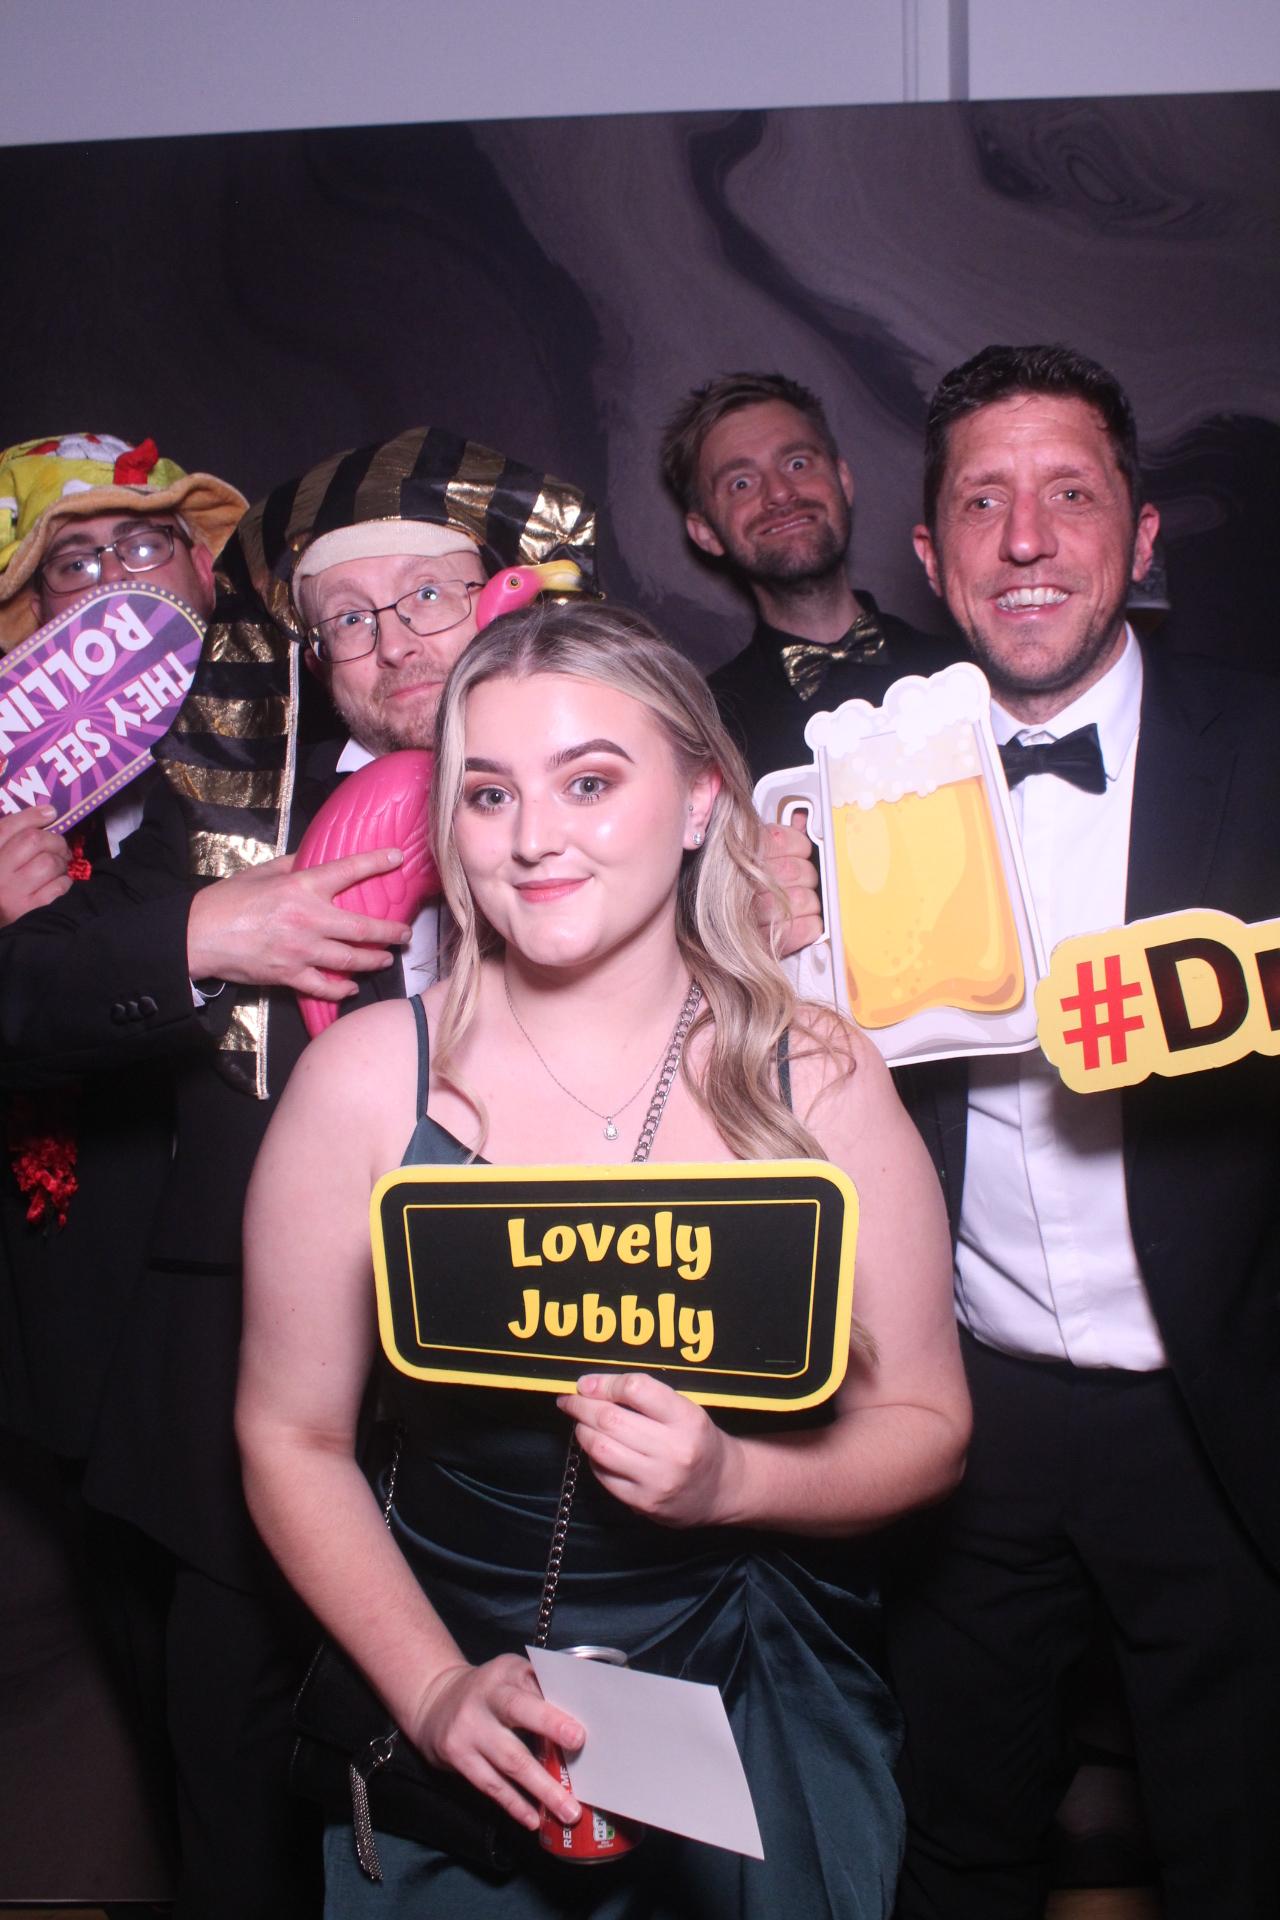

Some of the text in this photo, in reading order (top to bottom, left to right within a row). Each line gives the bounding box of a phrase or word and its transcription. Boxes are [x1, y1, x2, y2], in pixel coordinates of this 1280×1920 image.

[105, 652, 196, 737] THEY
[40, 719, 110, 787] SEE
[507, 1211, 713, 1281] Lovely
[507, 1289, 715, 1363] Jubbly
